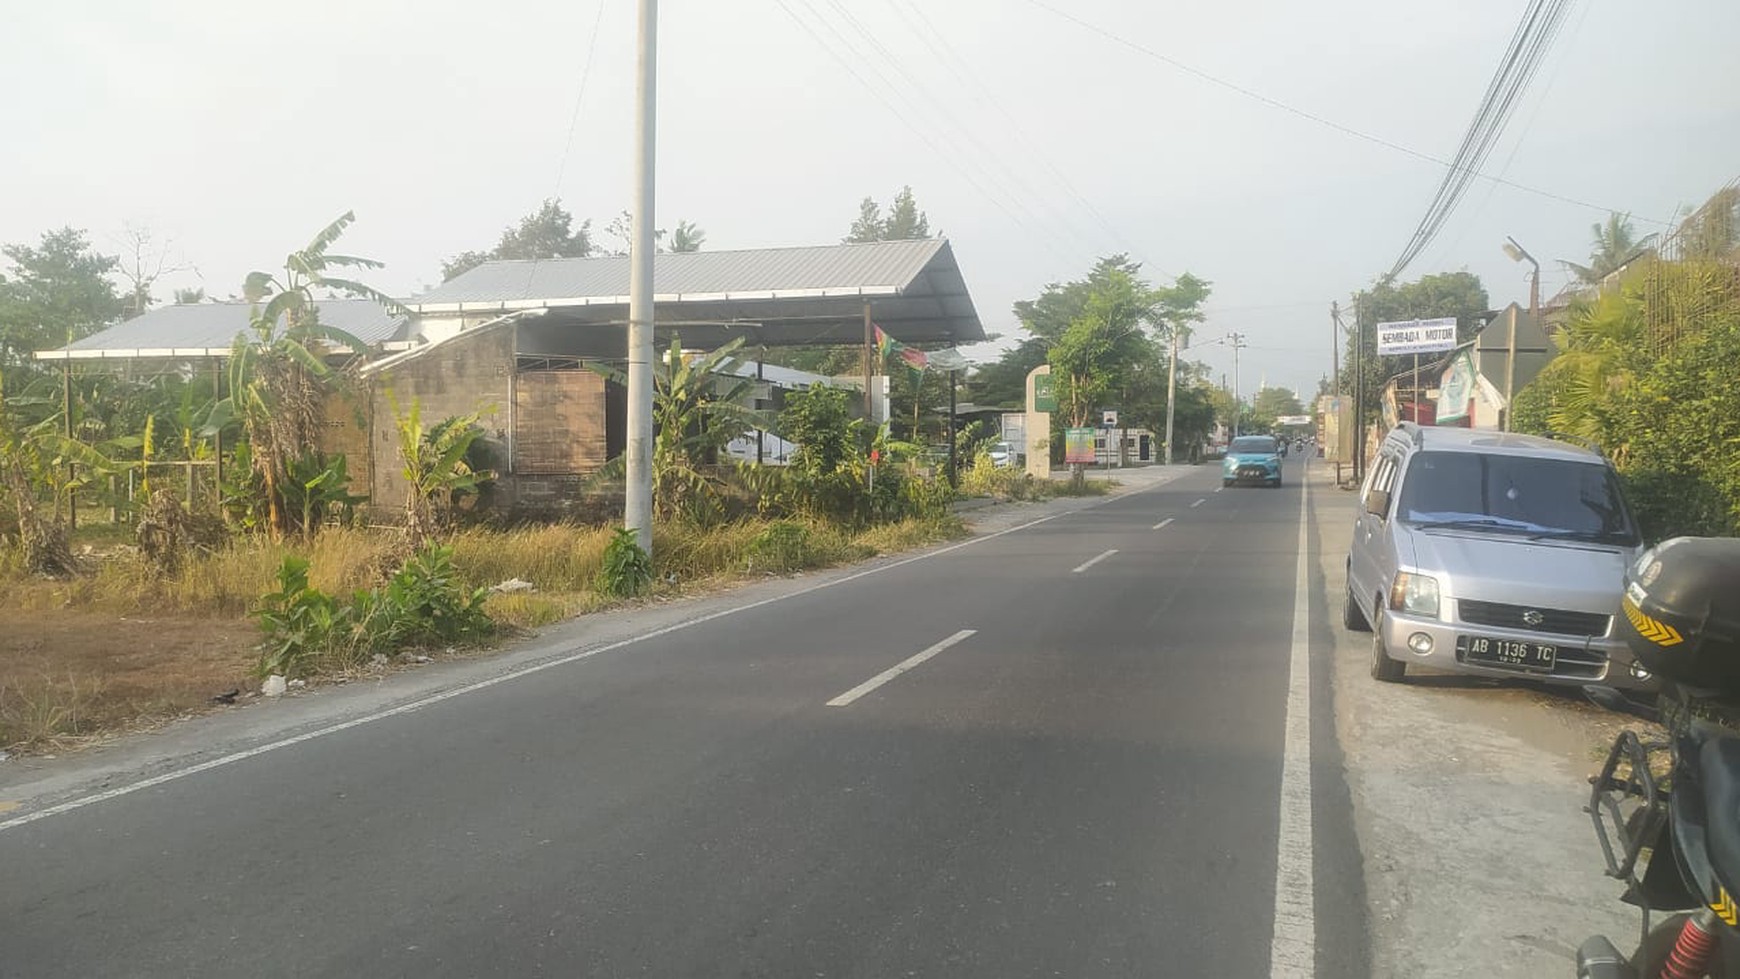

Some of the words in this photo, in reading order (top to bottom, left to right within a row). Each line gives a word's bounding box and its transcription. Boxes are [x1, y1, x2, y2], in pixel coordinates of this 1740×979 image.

[1382, 331, 1420, 344] SEMBADA
[1425, 328, 1454, 340] MOTOR
[1472, 639, 1489, 653] AB
[1497, 641, 1527, 658] 1136
[1537, 646, 1552, 660] TC
